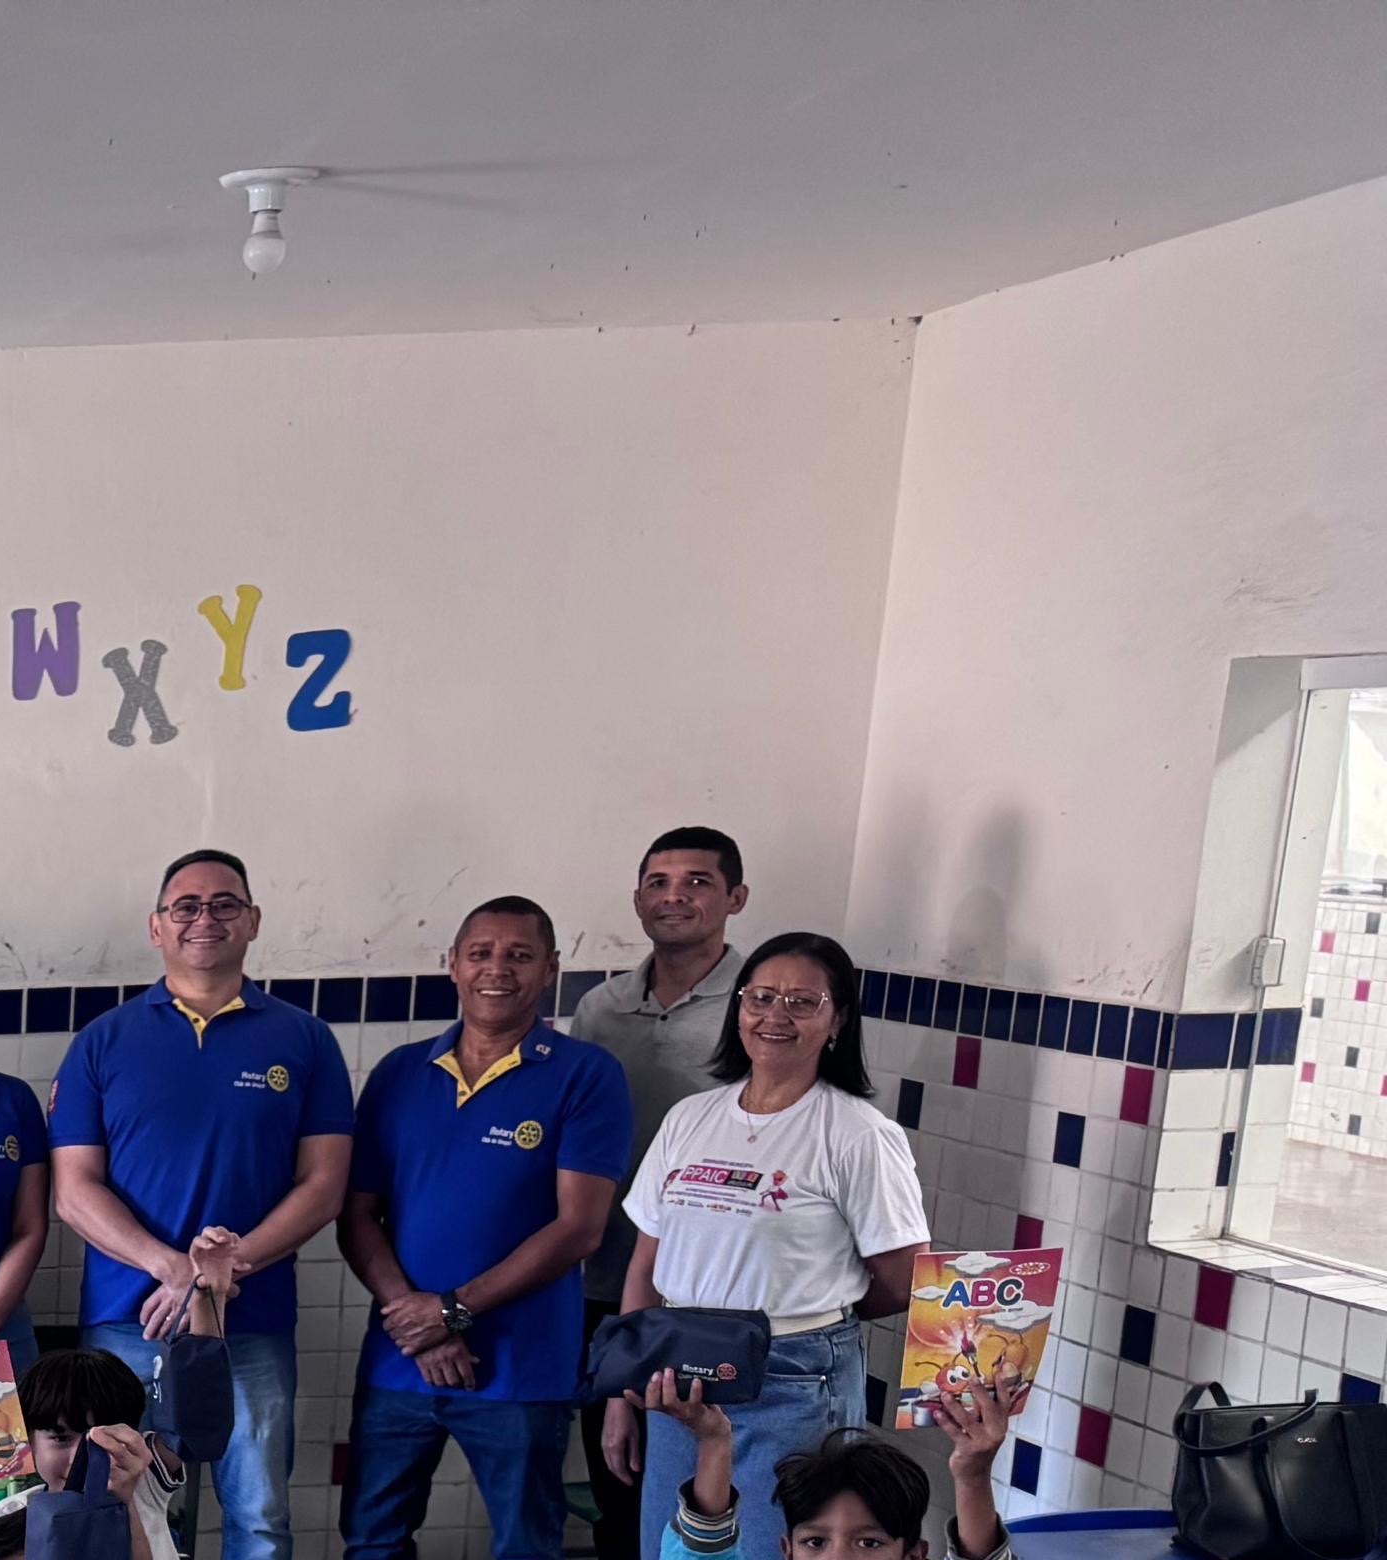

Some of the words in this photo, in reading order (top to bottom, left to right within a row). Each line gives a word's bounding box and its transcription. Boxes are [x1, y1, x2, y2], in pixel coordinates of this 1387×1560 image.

[10, 600, 82, 702] W
[101, 639, 179, 747] X
[197, 583, 263, 691] Y
[285, 628, 353, 732] Z
[683, 1166, 728, 1184] PPAIC
[942, 1278, 1024, 1308] ABC
[682, 1363, 714, 1377] Rotary
